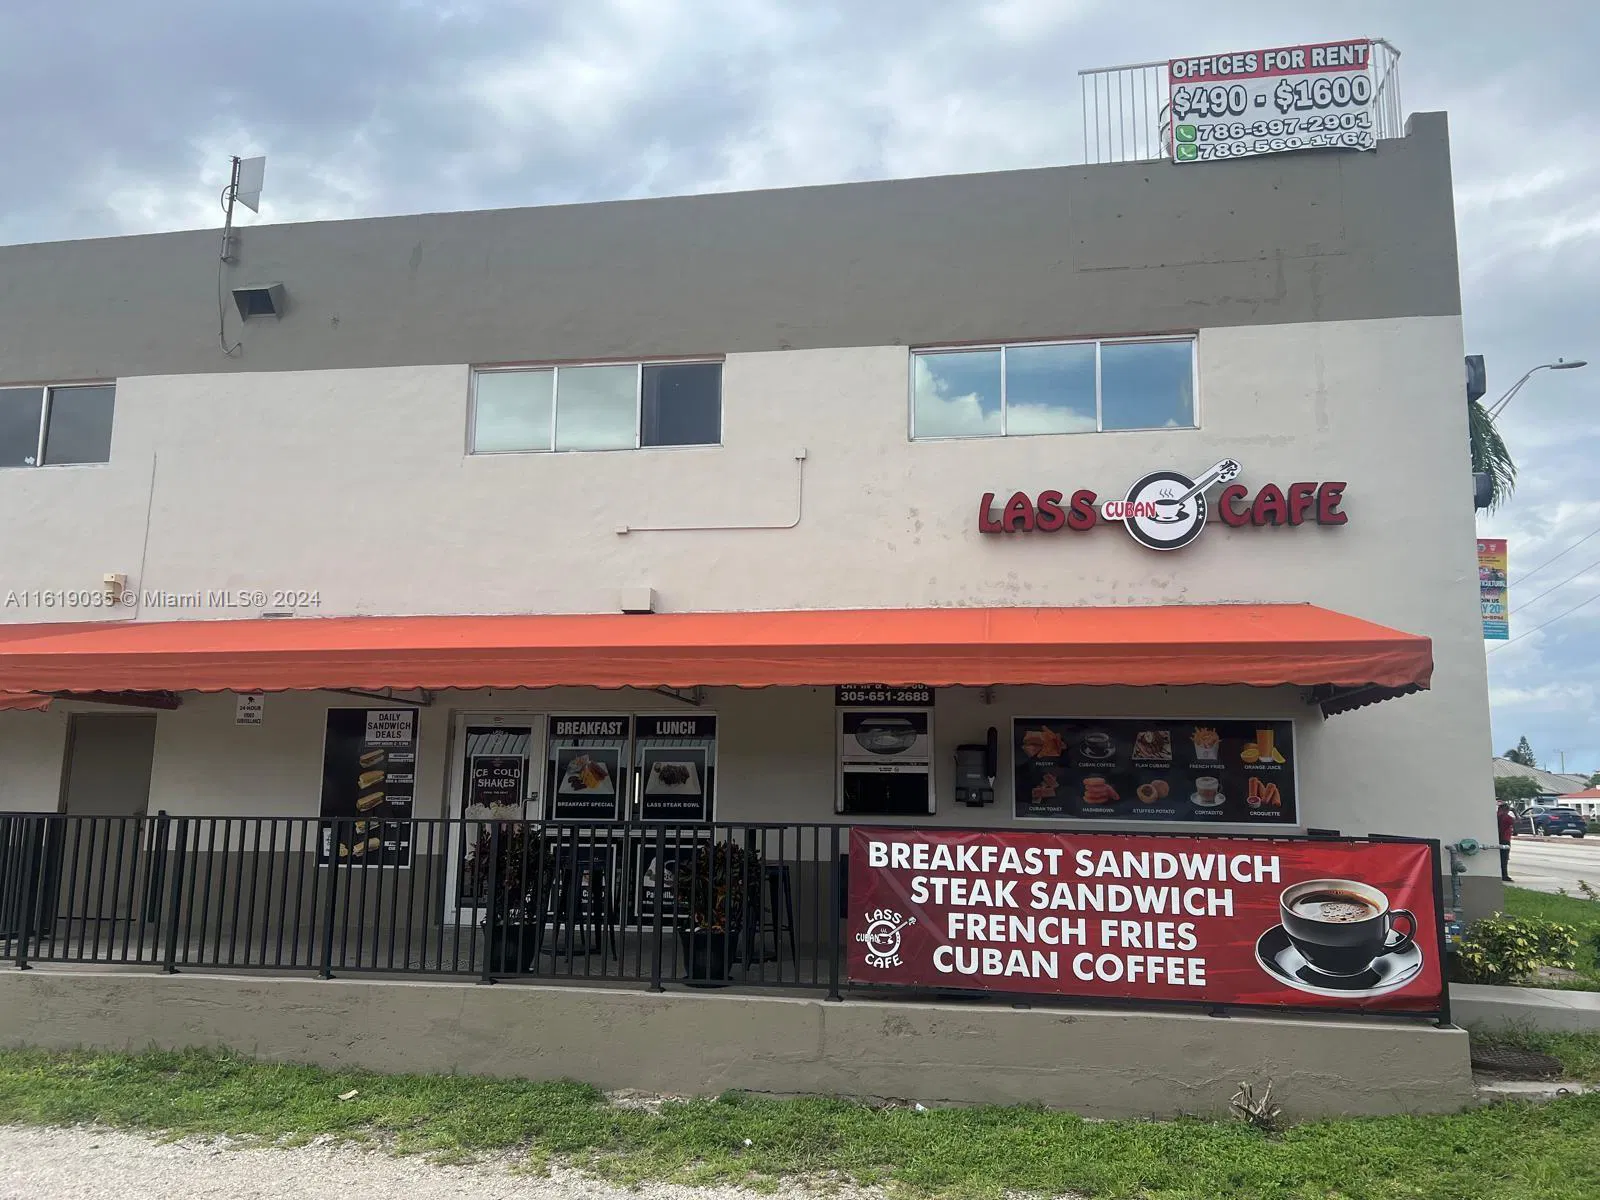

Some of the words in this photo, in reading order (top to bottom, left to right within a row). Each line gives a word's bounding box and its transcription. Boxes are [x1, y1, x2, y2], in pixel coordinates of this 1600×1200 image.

[1172, 53, 1258, 78] OFFICES
[1264, 49, 1305, 70] FOR
[1311, 44, 1368, 67] RENT
[1173, 84, 1247, 120] $490
[1274, 75, 1371, 113] $1600
[1199, 112, 1372, 140] 786-397-2901
[1199, 131, 1373, 160] 786-560-1764
[978, 489, 1098, 534] LASS
[1105, 501, 1157, 518] CUBAN
[1218, 481, 1348, 527] CAFE
[841, 691, 929, 701] 305-651-2688
[379, 713, 401, 721] DAILY
[367, 722, 411, 730] SANDWICH
[556, 721, 623, 735] BREAKFAST
[656, 721, 696, 735] LUNCH
[375, 730, 402, 738] DEALS
[472, 769, 488, 778] ICE
[494, 769, 520, 778] COLD
[477, 778, 515, 788] SHAKES
[868, 841, 1063, 875] BREAKFAST
[1075, 849, 1281, 883] SANDWICH
[910, 876, 1019, 908] STEAK
[1030, 882, 1234, 917] SANDWICH
[864, 908, 902, 924] LASS
[855, 932, 879, 942] CUBAN
[947, 912, 1086, 946] FRENCH
[1101, 919, 1198, 952] FRIES
[864, 953, 904, 968] CAFE
[933, 945, 1059, 979] CUBAN
[1072, 952, 1207, 987] COFFEE
